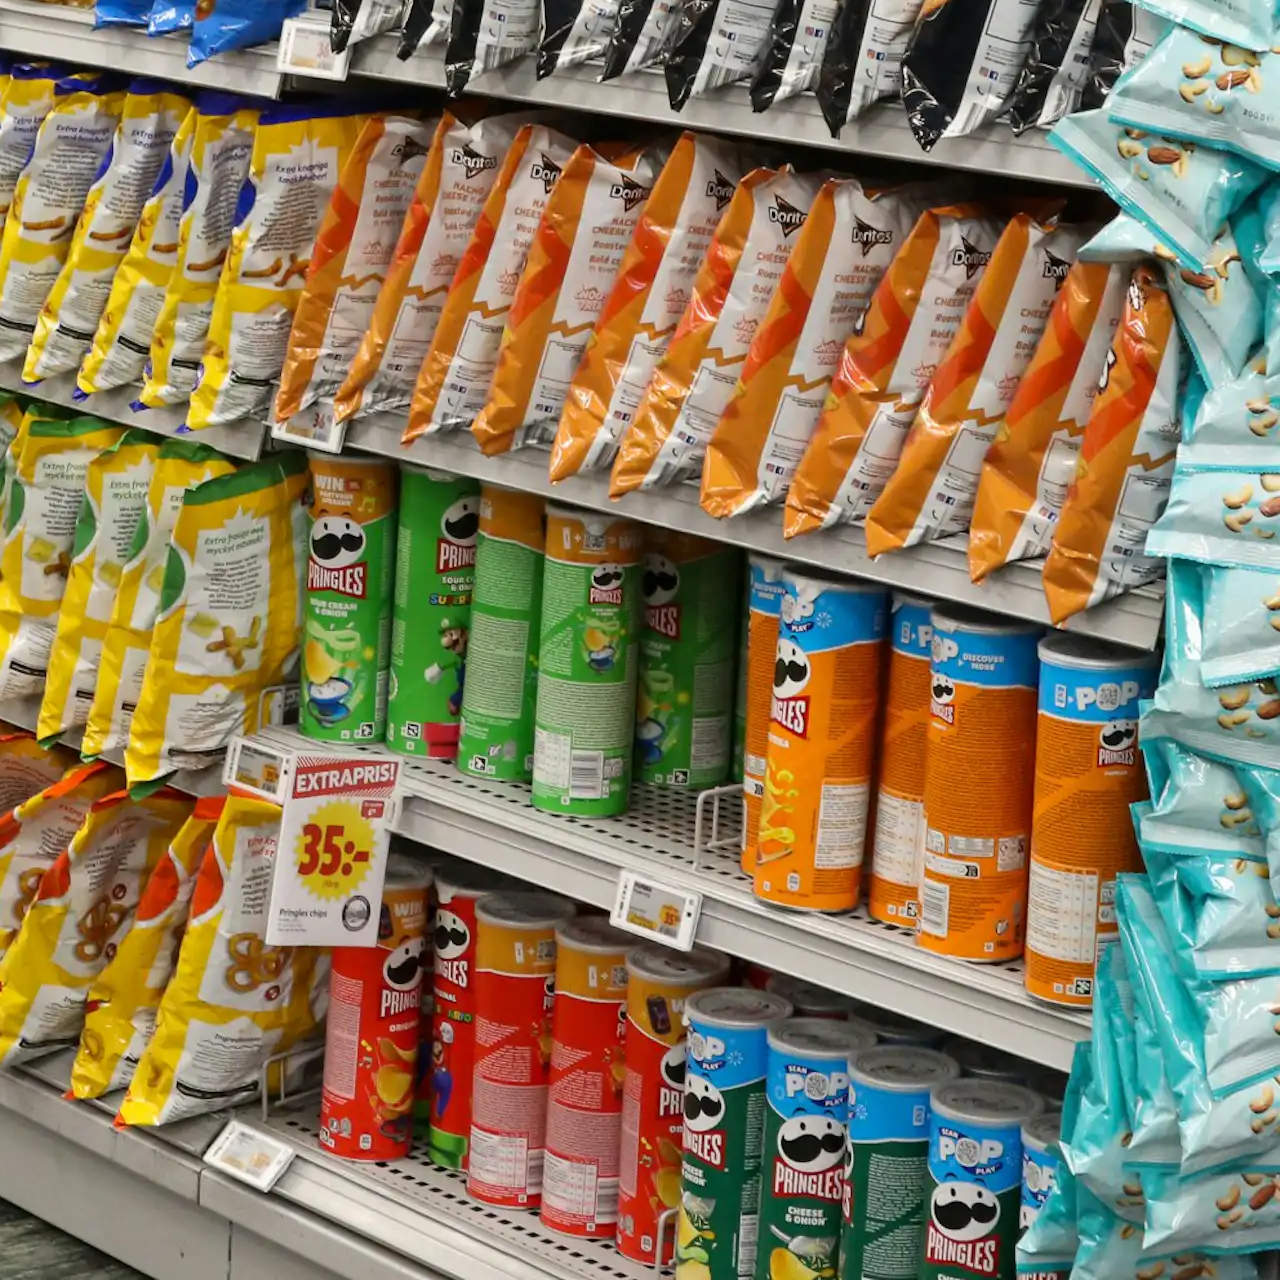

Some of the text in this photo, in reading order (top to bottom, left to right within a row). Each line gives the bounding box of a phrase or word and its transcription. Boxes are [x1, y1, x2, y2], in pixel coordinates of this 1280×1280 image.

[55, 123, 77, 134] Extra
[452, 150, 497, 170] Doritos
[769, 207, 808, 223] Dorito
[613, 218, 637, 227] NACH
[592, 227, 626, 237] CHEESE
[852, 227, 893, 244] Doritos
[593, 240, 627, 249] Roaste
[589, 255, 609, 264] Bold
[834, 274, 867, 284] CHEESE
[42, 462, 62, 471] Extra
[44, 471, 74, 481] mycket
[110, 480, 130, 489] Extra
[314, 474, 344, 491] WIN
[204, 534, 226, 546] Extra
[307, 560, 364, 595] PRINGLES
[442, 576, 465, 584] SOUR
[589, 587, 623, 605] PRINGLES
[328, 599, 357, 611] CREAM
[791, 623, 807, 632] PLAY
[962, 653, 1004, 663] DISCOVER
[971, 662, 995, 671] MORE
[1075, 681, 1139, 711] POP
[1099, 747, 1134, 766] PRINGLES
[296, 763, 395, 793] EXTRAPRIS!
[298, 823, 369, 877] 35:-
[279, 908, 327, 920] Pringles chips
[394, 901, 424, 917] WIN
[381, 990, 420, 1018] PRINGL
[703, 1061, 720, 1070] PLAY
[788, 1065, 807, 1074] SCAN
[786, 1072, 849, 1100] POP
[825, 1098, 843, 1106] PLAY
[941, 1127, 959, 1137] SCAN
[939, 1135, 1003, 1167] POP
[975, 1166, 996, 1175] PLAY
[775, 1161, 843, 1200] PRINGLES
[788, 1206, 824, 1216] CHEESE
[785, 1214, 825, 1226] & ONION
[927, 1226, 996, 1272] PRINGLES
